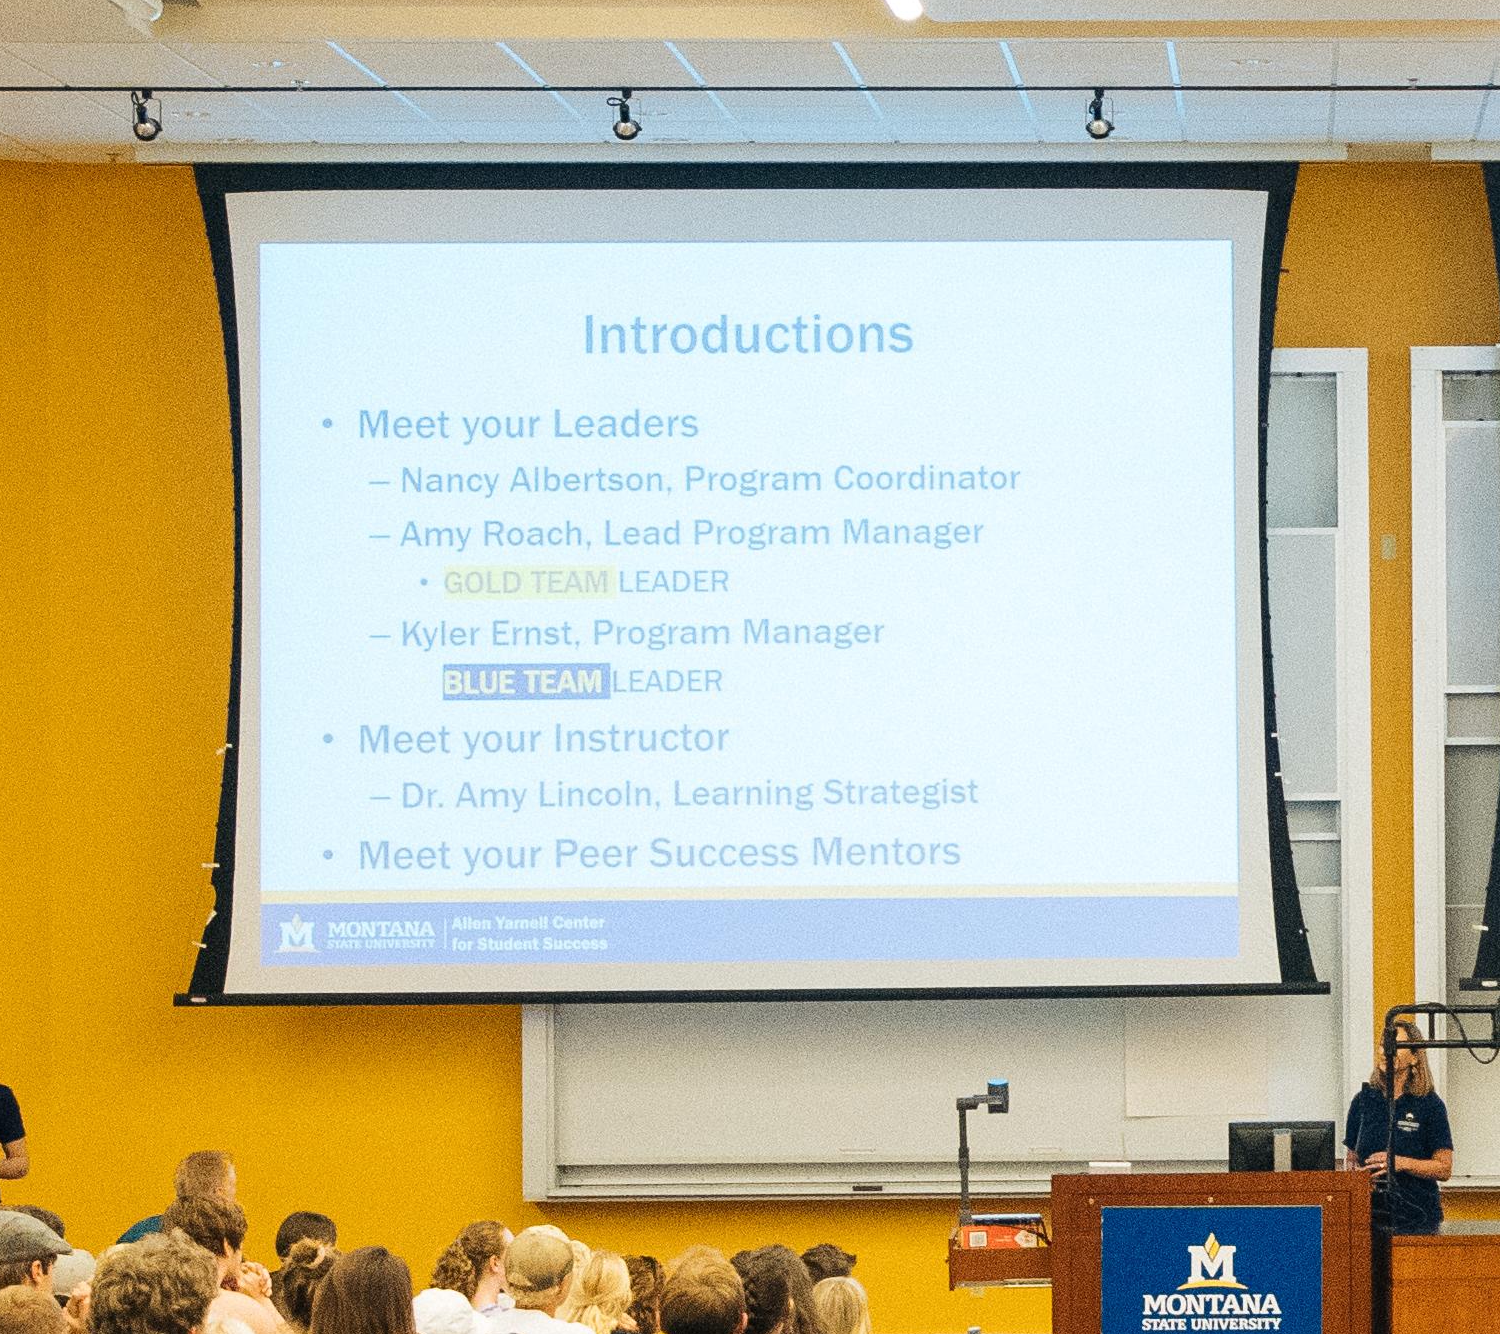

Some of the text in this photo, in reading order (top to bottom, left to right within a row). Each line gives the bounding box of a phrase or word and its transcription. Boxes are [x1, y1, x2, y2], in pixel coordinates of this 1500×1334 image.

[585, 315, 914, 354] Introductions
[359, 409, 699, 445] Meet your Leaders
[401, 465, 1021, 498] Nancy Albertson, Program Coordinator
[400, 519, 984, 552] Amy Roach, Lead Program Manager
[445, 571, 729, 594] GOLD TEAM LEADER
[402, 619, 884, 652] Kyler Ernst, Program Manager
[444, 670, 722, 694] BLUE TEAM LEADER
[360, 723, 730, 759] Meet your Instructor
[402, 779, 979, 813] Dr. Amy Lincoln, Learning Strategist
[360, 837, 961, 875] Meet your Peer Success Mentors
[328, 921, 435, 938] MONTANA
[452, 915, 605, 931] Allen Yarnell Center
[328, 939, 435, 949] STATE UNIVERSITY
[452, 937, 608, 951] for Student Success
[1142, 1294, 1282, 1315] MONTANA
[1142, 1318, 1282, 1331] STATE UNIVERSITY
